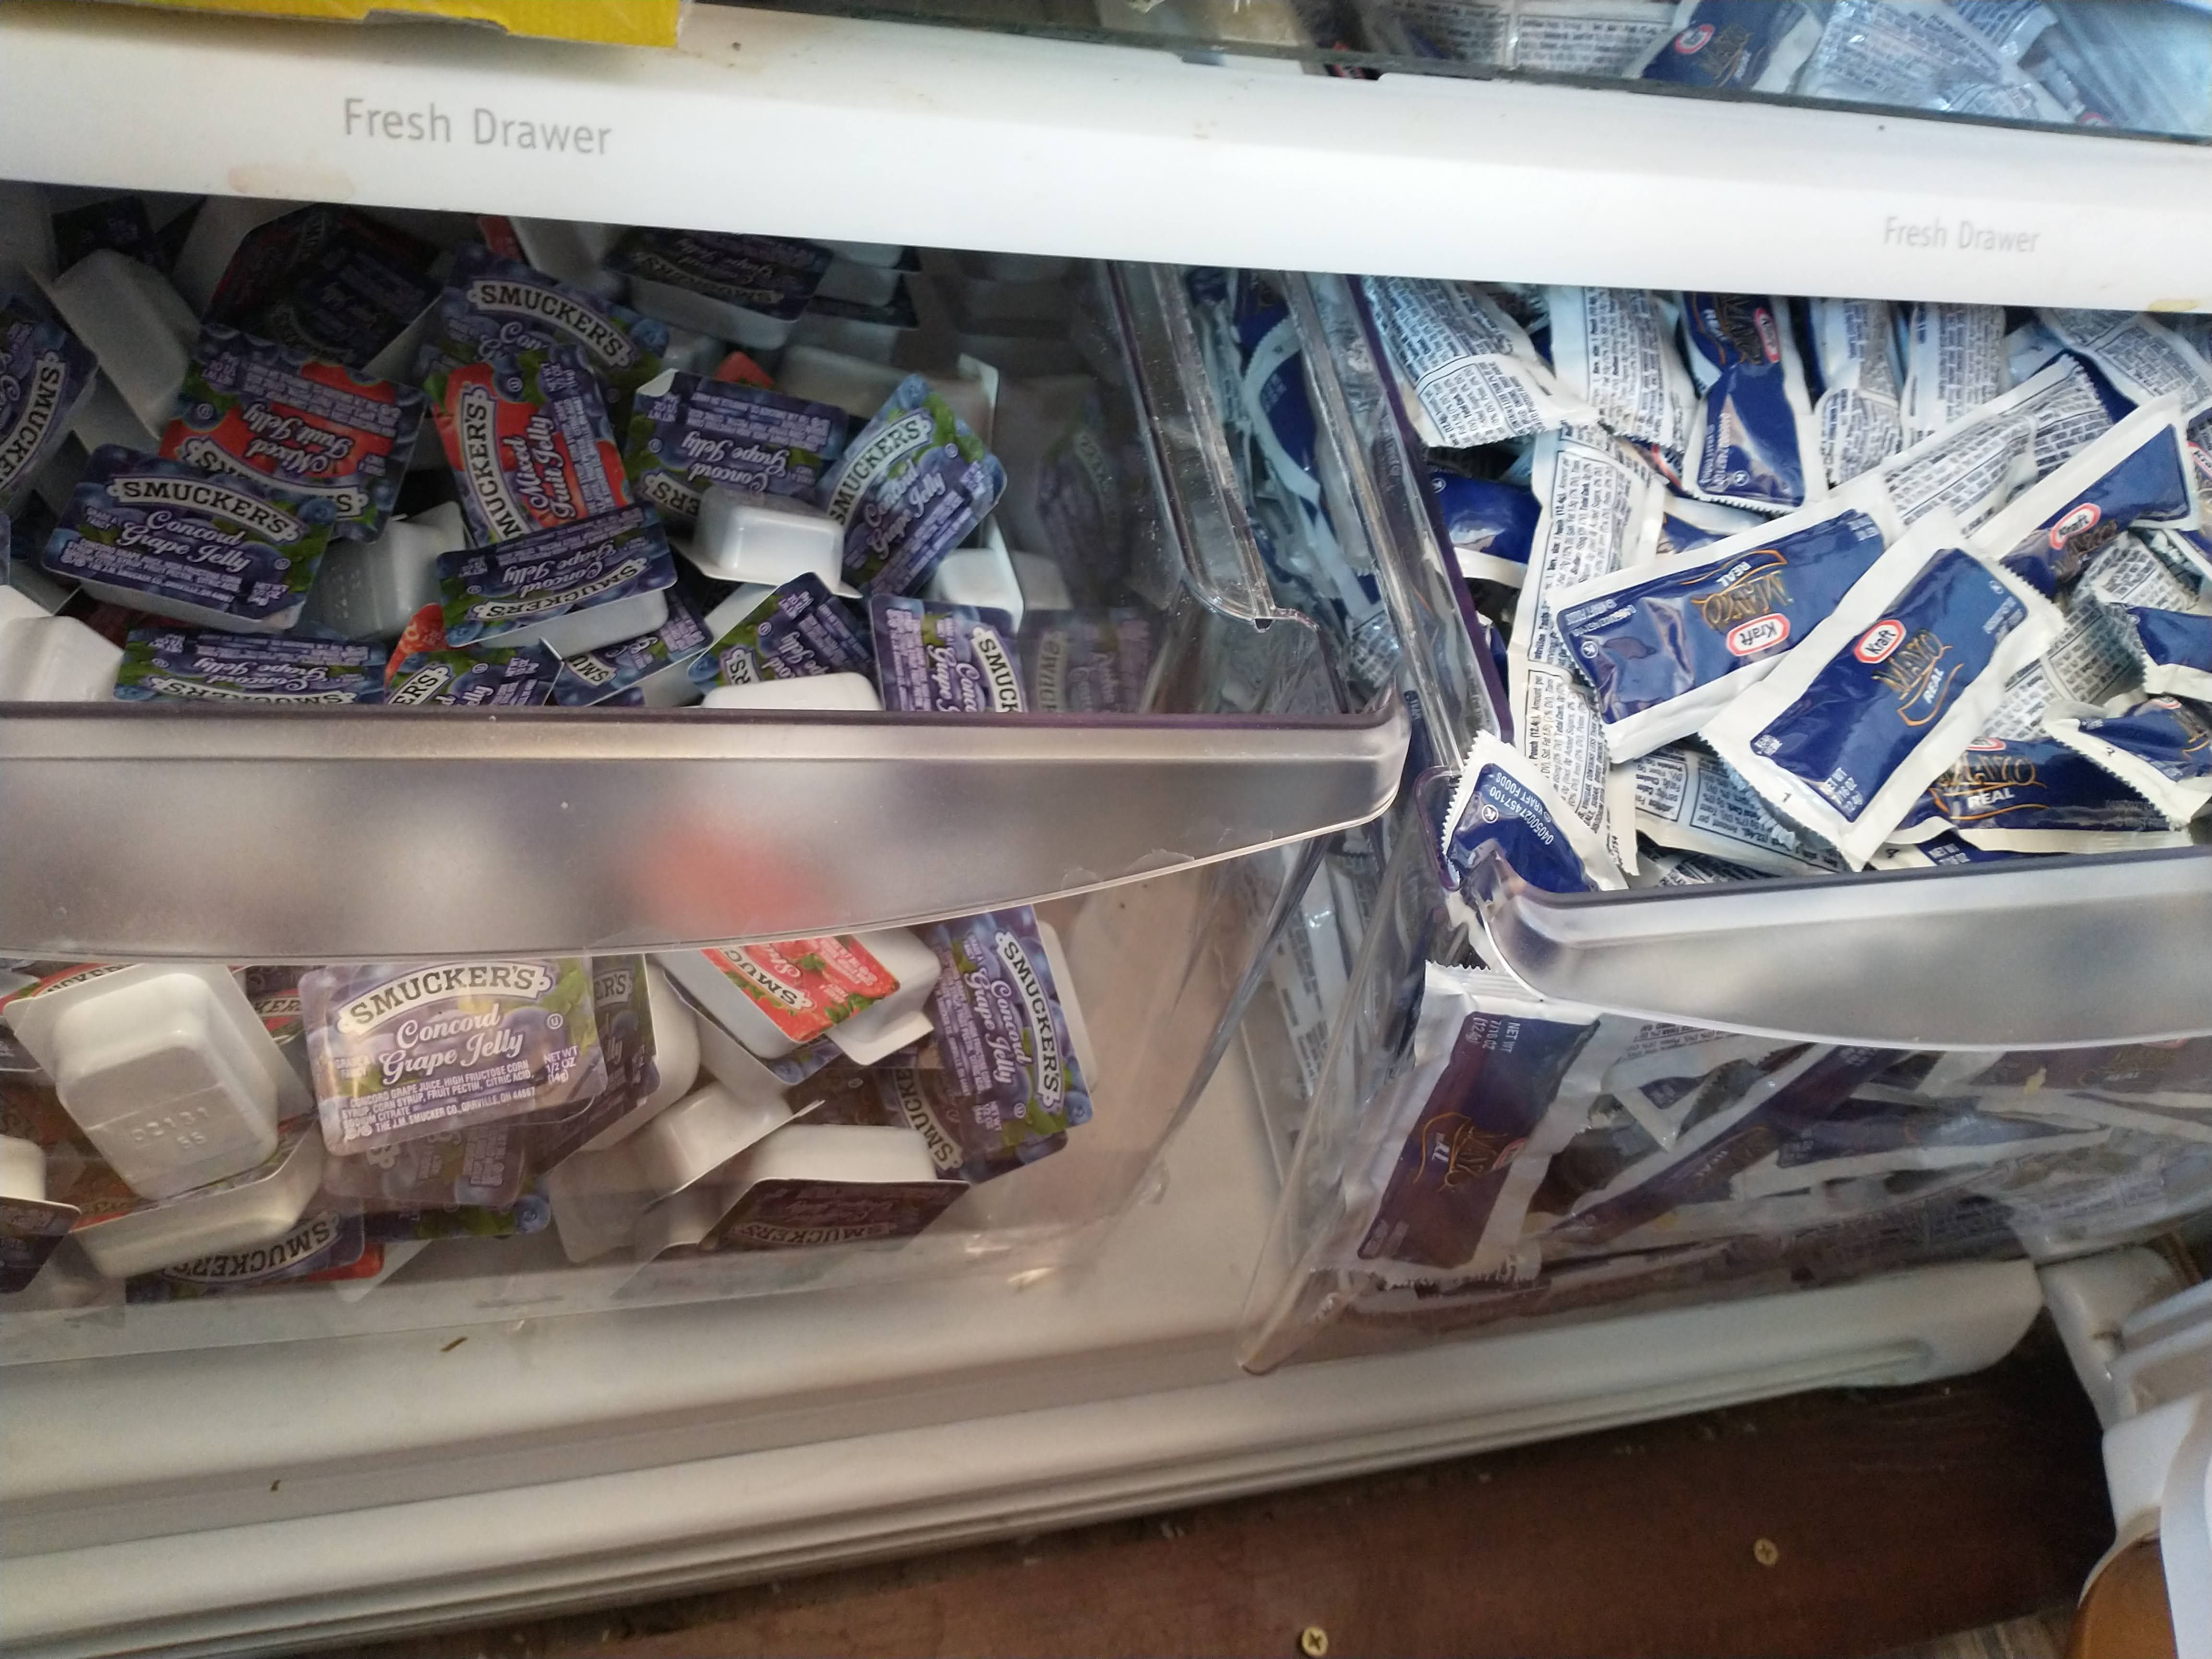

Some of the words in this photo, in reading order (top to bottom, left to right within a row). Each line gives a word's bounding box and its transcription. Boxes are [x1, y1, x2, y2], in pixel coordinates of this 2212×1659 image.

[344, 97, 451, 143] Fresh
[472, 107, 613, 155] Drawer
[1884, 216, 1947, 248] Fresh
[1959, 220, 2041, 253] Drawer
[481, 284, 625, 357] SMUCKER'S
[0, 366, 60, 480] SMUCKE
[242, 401, 303, 440] Jelly
[245, 438, 329, 474] Mixed
[295, 427, 354, 459] Fruit
[526, 414, 565, 469] Jelly
[680, 430, 734, 463] Jelly
[464, 403, 522, 539] MUCKER'S
[502, 435, 549, 510] Mixed
[687, 462, 768, 493] Concord
[732, 444, 791, 479] Grape
[123, 481, 290, 534] SMUCKER'S
[542, 465, 577, 519] Fruit
[909, 472, 946, 519] Jelly
[116, 521, 190, 556] Grape
[186, 541, 252, 573] Jelly
[147, 510, 246, 547] Concord
[503, 559, 556, 585] Jelly
[556, 541, 616, 570] Grape
[486, 564, 638, 617] SMUCKER'S
[519, 562, 603, 599] Concord
[1716, 561, 1753, 588] REAL
[1740, 622, 1778, 646] Kraft
[1865, 629, 1897, 655] Kraft
[192, 656, 257, 675] Jelly
[206, 674, 308, 691] Concord
[258, 663, 329, 682] Grape
[926, 645, 957, 700] Grape
[1923, 668, 1946, 704] REAL
[1496, 772, 1521, 797] FOODS
[1967, 787, 2016, 809] REAL
[1520, 791, 1543, 816] KRAFT
[349, 965, 536, 1025] SMUCKER'S
[395, 1003, 501, 1049] Concord
[963, 966, 996, 1031] Grape
[986, 1032, 1016, 1084] Jelly
[991, 980, 1033, 1065] Concord
[1003, 941, 1059, 1093] SMUCKER'S
[1505, 1022, 1521, 1041] NET
[378, 1048, 457, 1085] Grape
[460, 1029, 525, 1068] Jelly
[543, 1051, 561, 1064] NET
[562, 1046, 578, 1058] WT
[561, 1057, 577, 1068] OZ
[391, 1084, 418, 1099] GRAPE
[444, 1074, 464, 1087] HIGH
[465, 1065, 506, 1083] FRUCTOSE
[506, 1059, 529, 1073] CORN
[427, 1087, 451, 1100] FRUIT
[485, 1075, 512, 1087] CITRIC
[374, 1119, 392, 1133] THE
[408, 1107, 446, 1124] SMUCKER
[377, 1106, 411, 1122] CITRATE
[896, 1069, 954, 1163] SMUCKE
